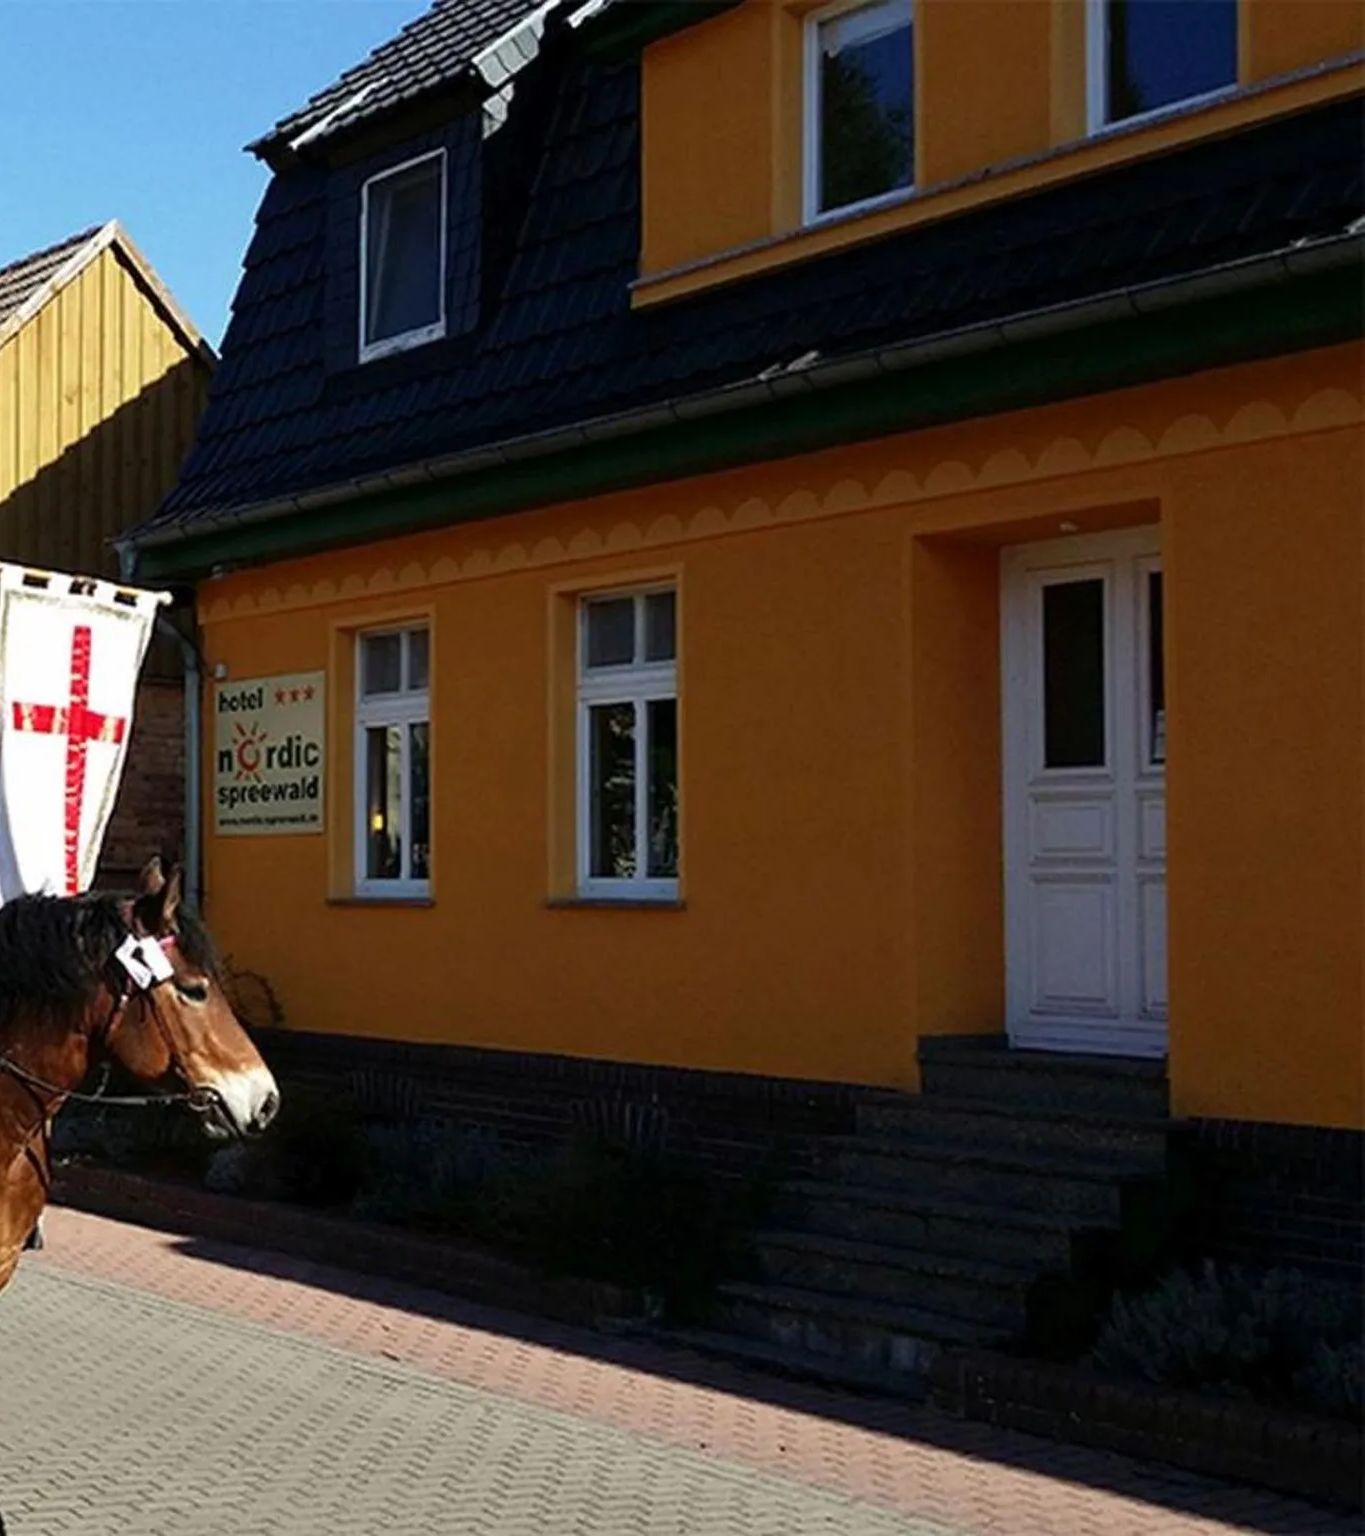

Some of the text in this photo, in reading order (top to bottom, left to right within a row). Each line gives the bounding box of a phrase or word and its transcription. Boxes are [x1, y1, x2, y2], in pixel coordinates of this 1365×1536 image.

[218, 687, 264, 712] hotel
[218, 735, 319, 773] nordic
[218, 776, 319, 809] spreewald
